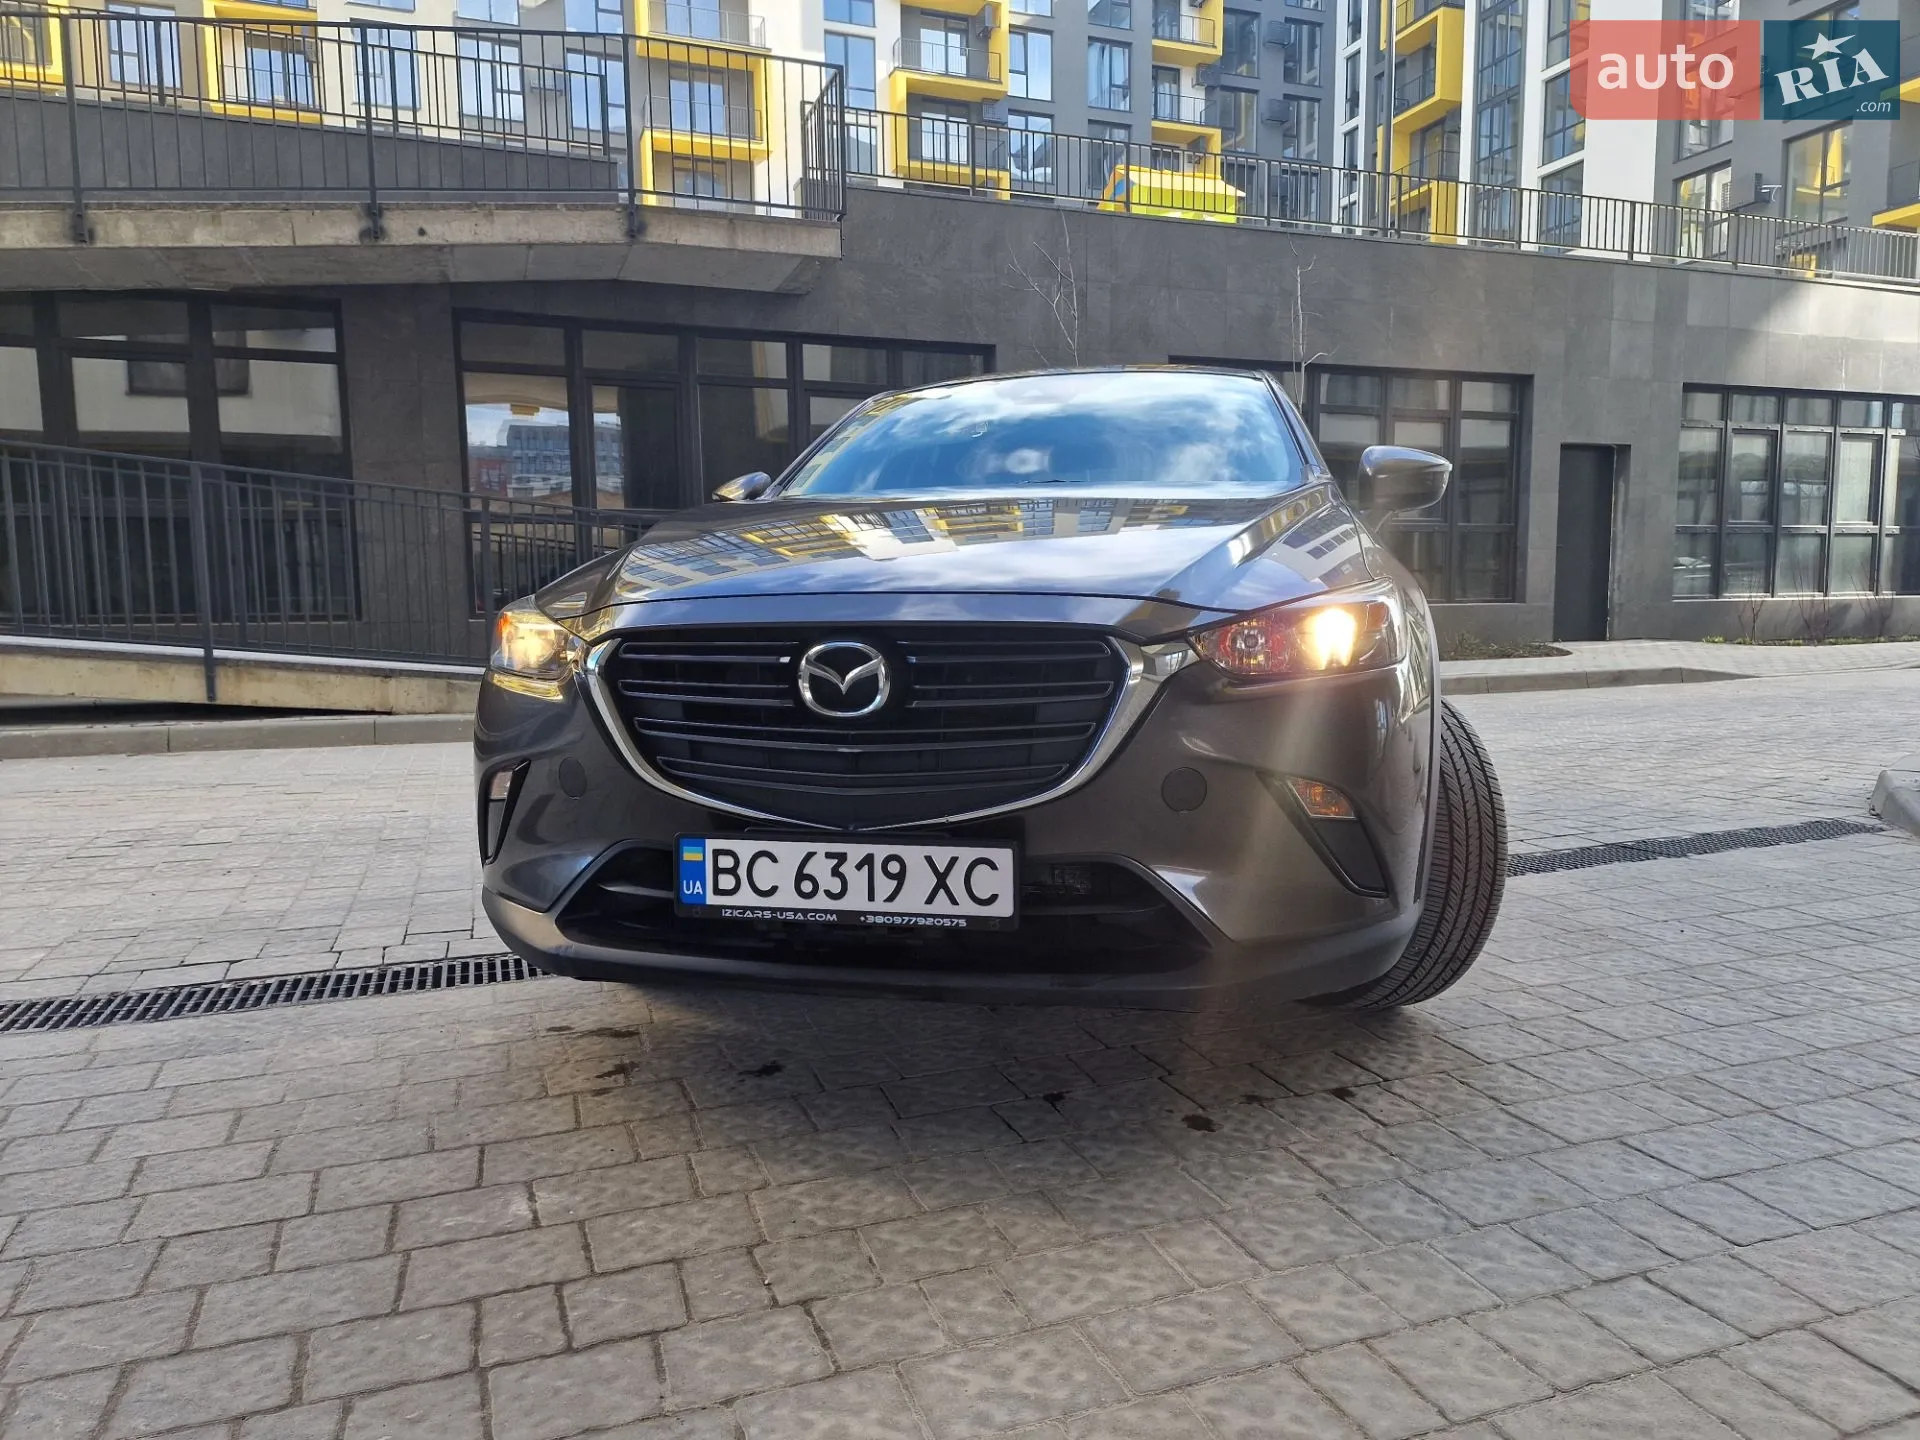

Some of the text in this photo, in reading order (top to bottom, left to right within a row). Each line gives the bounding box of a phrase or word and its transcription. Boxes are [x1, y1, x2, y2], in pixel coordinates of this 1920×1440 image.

[712, 848, 999, 907] BC 6319 XC
[683, 880, 703, 895] UA
[722, 908, 838, 922] IZICARS-USA.COM
